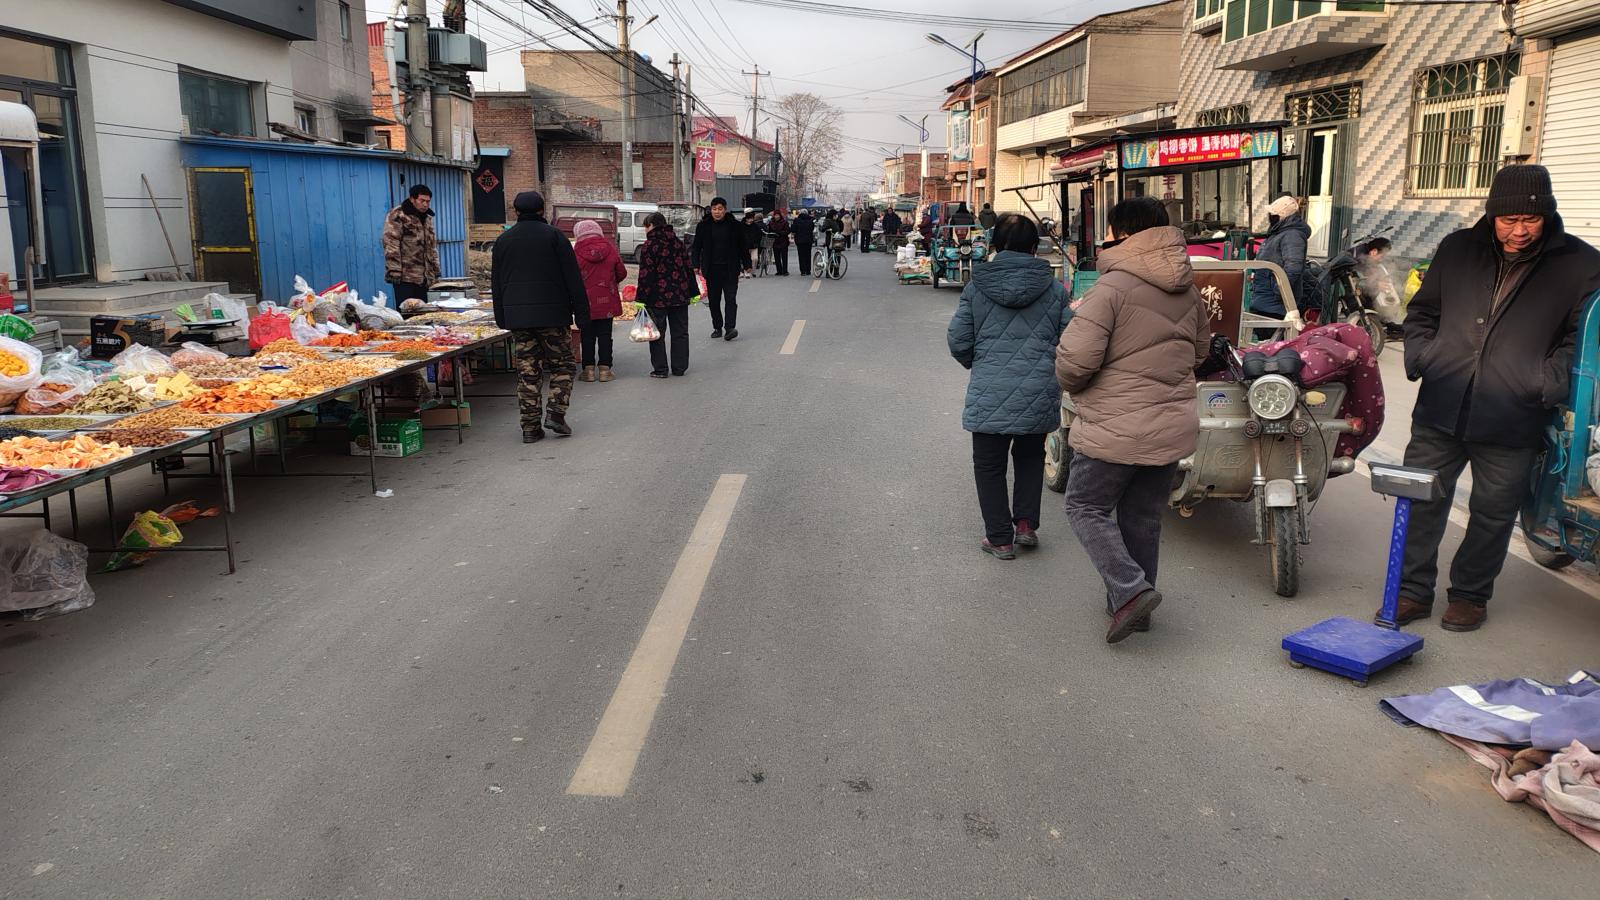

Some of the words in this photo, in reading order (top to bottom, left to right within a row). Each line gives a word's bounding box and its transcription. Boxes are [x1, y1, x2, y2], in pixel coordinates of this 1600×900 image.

[1201, 134, 1239, 151] 里脊肉饼
[699, 149, 712, 171] 水饺
